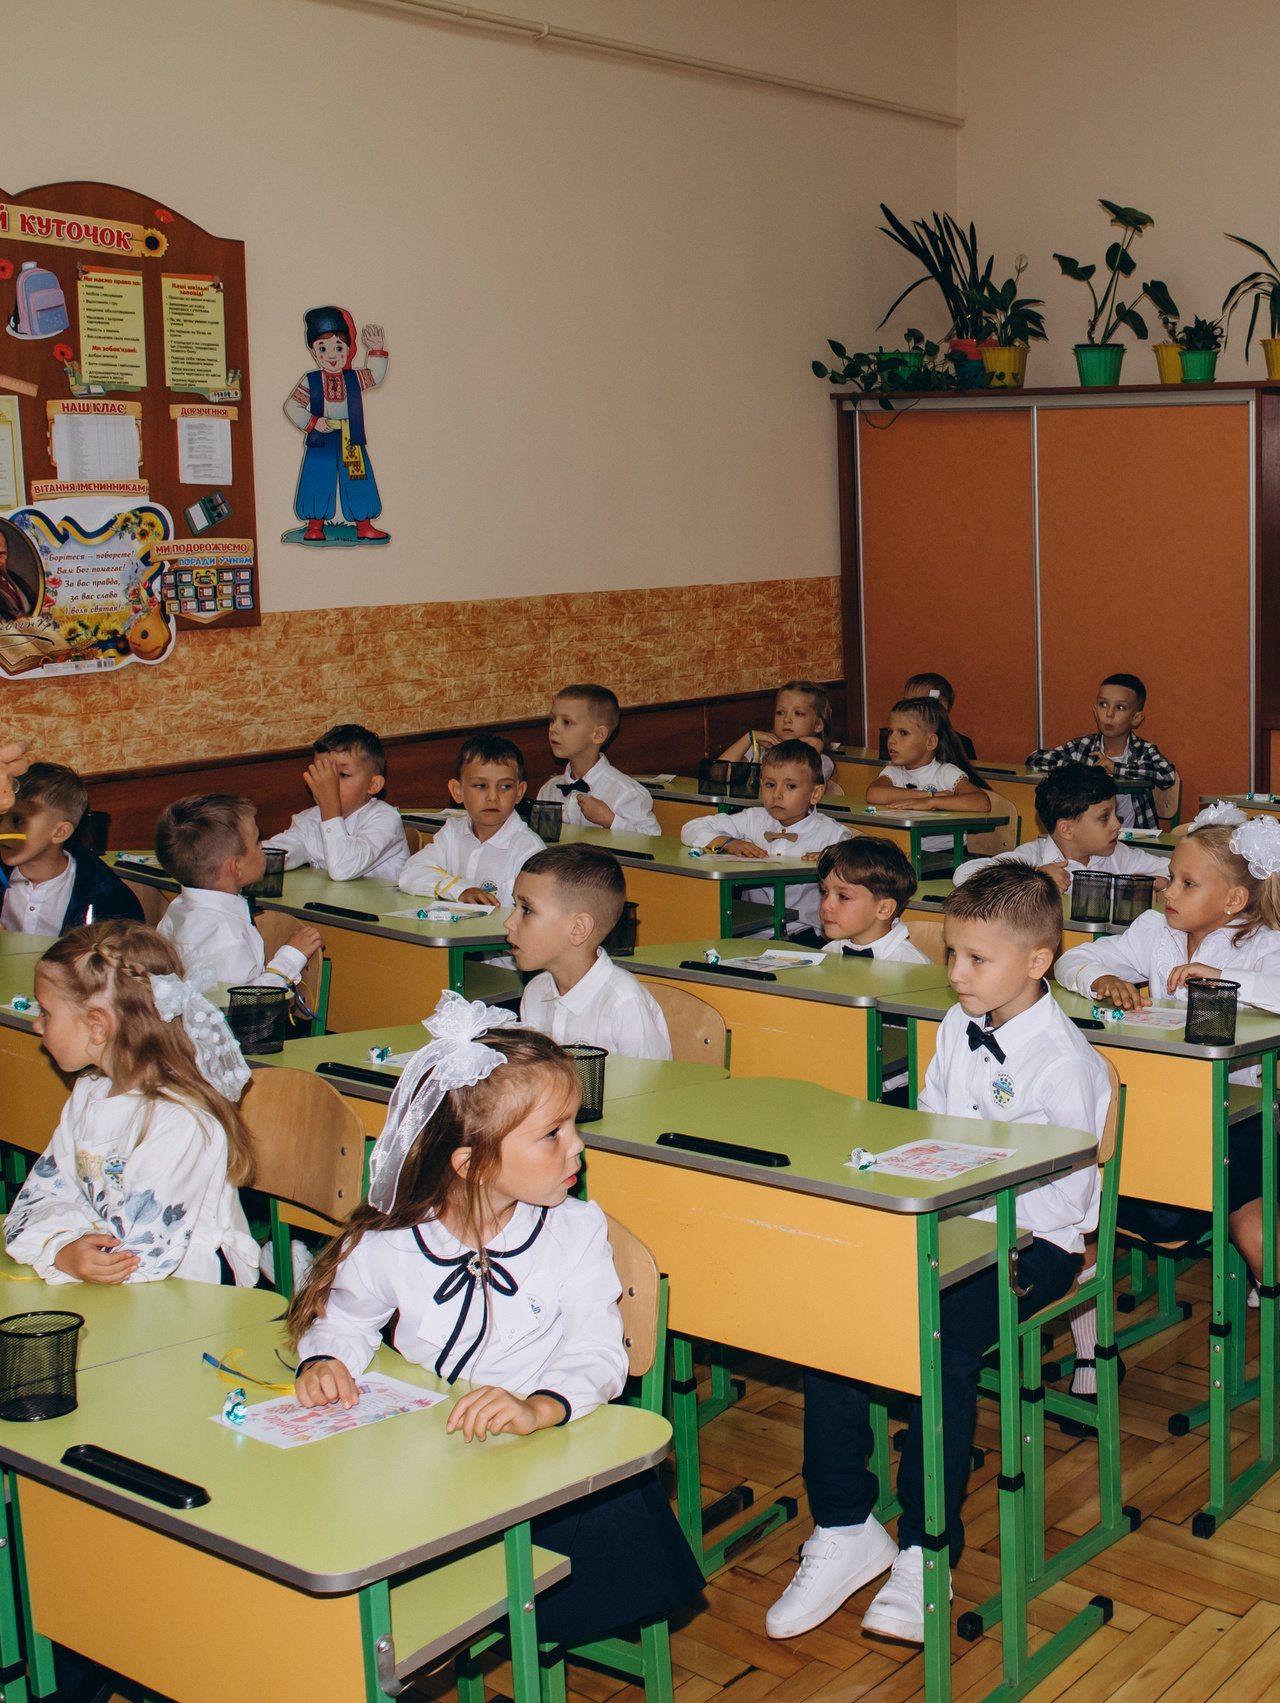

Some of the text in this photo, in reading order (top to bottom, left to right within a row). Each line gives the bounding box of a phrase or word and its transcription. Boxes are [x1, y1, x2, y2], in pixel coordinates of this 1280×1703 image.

[20, 214, 132, 250] КУТОЧОК
[62, 402, 125, 414] НАШ КЛАС
[181, 407, 228, 416] ДОРУЧЕННЯ
[34, 482, 146, 494] ВІТАННЯ ІМЕНИННИКАМ
[156, 544, 247, 554] МИ ПОДОРОЖУЄМО
[96, 550, 134, 560] поборете!
[179, 558, 216, 566] ПОРАДИ
[65, 580, 74, 588] За
[92, 578, 120, 587] правда,
[70, 591, 117, 603] за вас слава
[71, 606, 87, 614] воля
